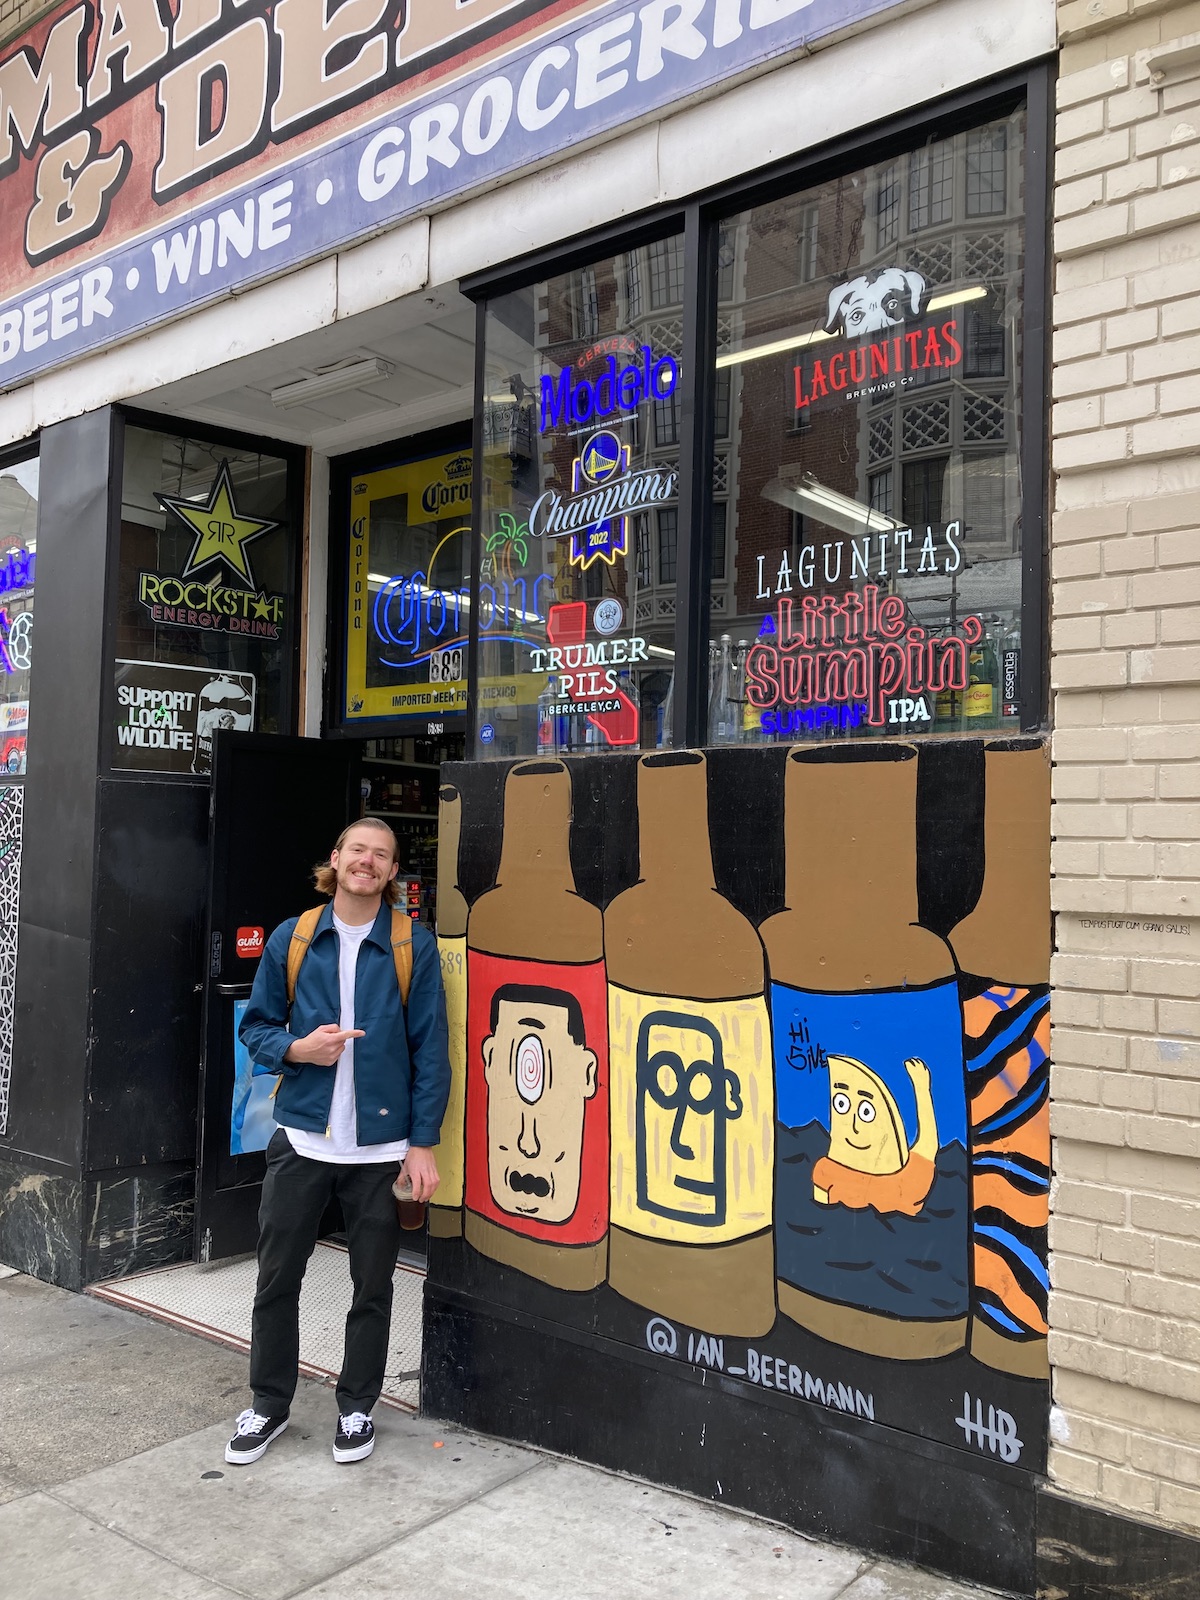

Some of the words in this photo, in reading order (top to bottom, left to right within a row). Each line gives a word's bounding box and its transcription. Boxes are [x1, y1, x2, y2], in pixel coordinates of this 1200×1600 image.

[25, 129, 125, 256] &
[0, 266, 115, 363] BEER
[151, 180, 294, 294] WINE
[577, 337, 636, 368] CERVEZA
[793, 320, 963, 410] LAGUNITAS
[539, 345, 678, 433] Modelo
[846, 380, 896, 400] BREWING
[422, 481, 473, 515] Coro
[529, 470, 678, 538] Champions
[589, 531, 609, 547] 2022
[352, 516, 367, 629] Corona
[755, 521, 961, 600] LAGUNITAS
[152, 604, 222, 628] ENERGY
[229, 616, 278, 637] DRINK
[758, 614, 777, 637] A
[777, 584, 906, 652] Little
[529, 637, 649, 673] TRUMER
[745, 616, 983, 727] Sumpin'
[557, 669, 618, 699] PILS
[1005, 651, 1015, 700] essentia
[117, 685, 196, 711] SUPPORT
[392, 693, 432, 707] IMPORTED
[434, 690, 454, 704] BEER
[483, 686, 517, 700] MEXICO
[888, 696, 932, 724] IPA
[129, 706, 183, 730] LOCAL
[481, 729, 493, 739] ADT
[117, 725, 193, 750] WILDLIFE
[237, 937, 263, 947] GURU
[788, 1017, 810, 1044] Hi
